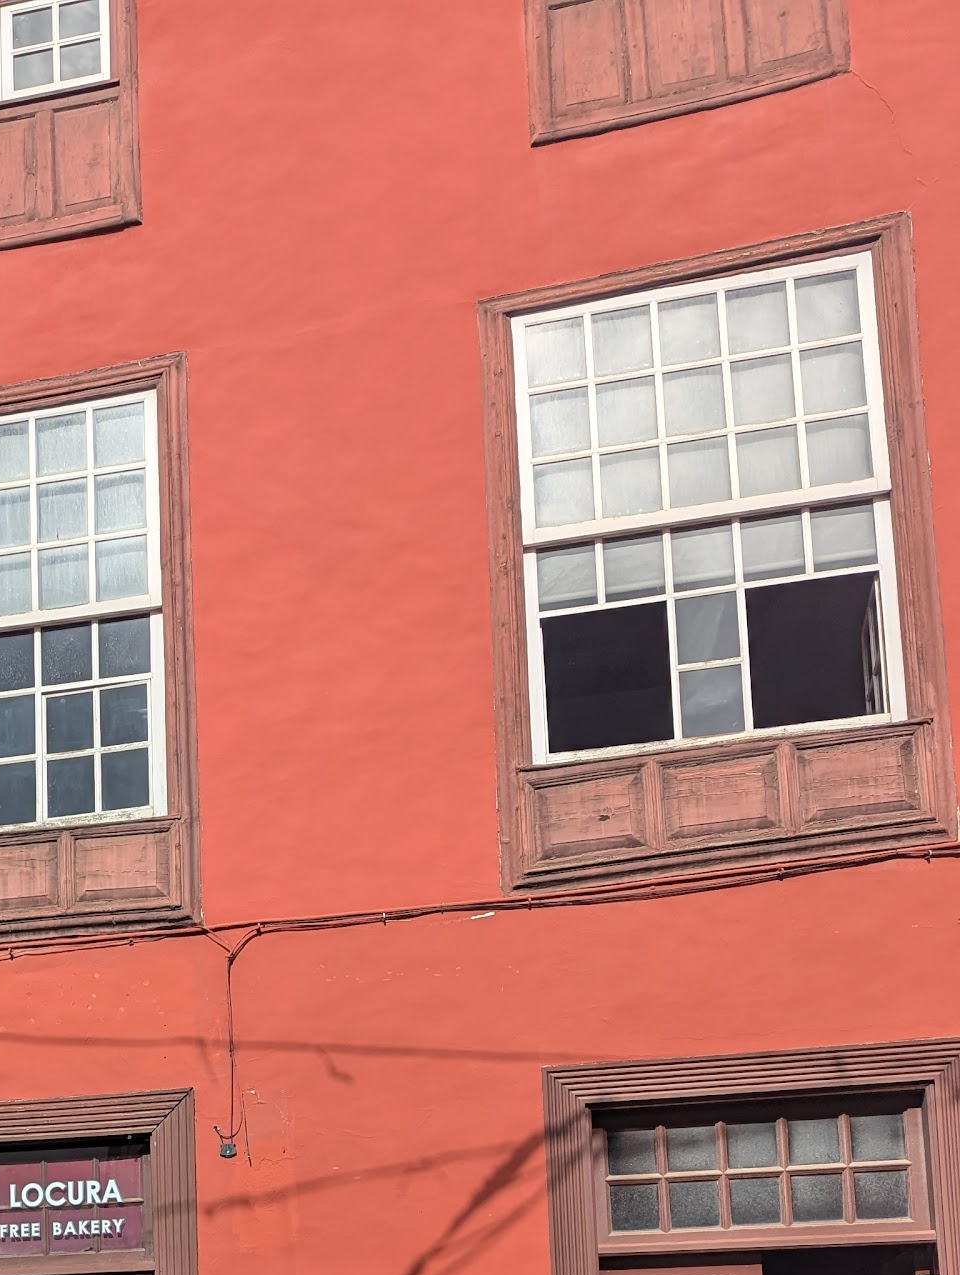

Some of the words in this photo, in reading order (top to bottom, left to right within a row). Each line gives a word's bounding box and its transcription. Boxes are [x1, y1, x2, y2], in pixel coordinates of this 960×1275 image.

[9, 1179, 124, 1208] LOCURA
[0, 1222, 41, 1239] FREE
[52, 1218, 125, 1237] BAKERY
